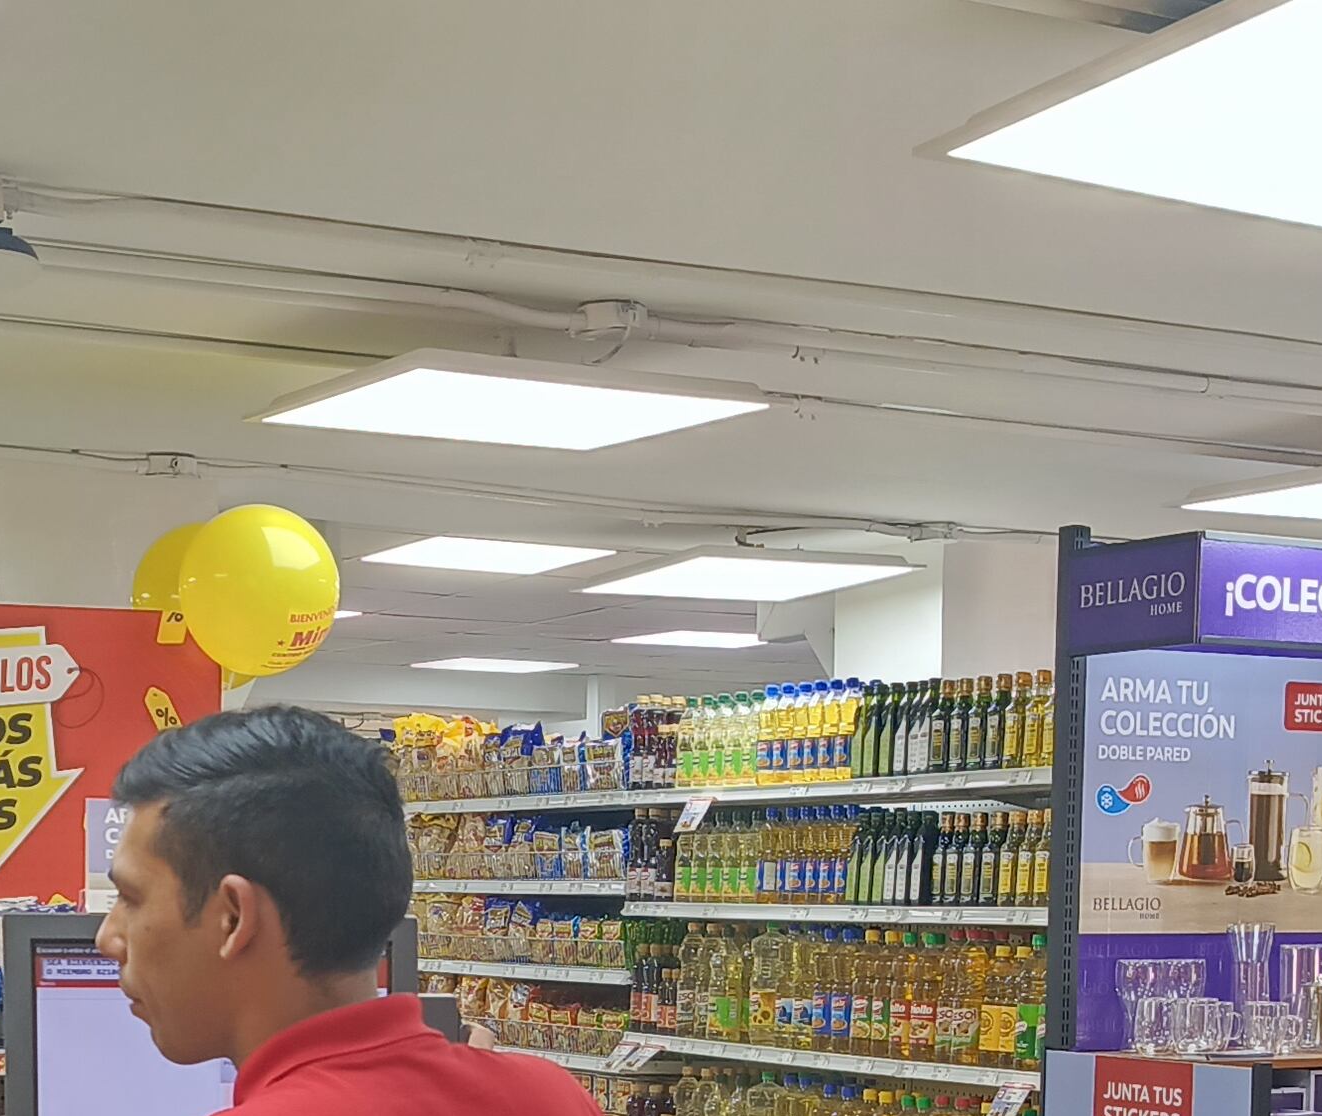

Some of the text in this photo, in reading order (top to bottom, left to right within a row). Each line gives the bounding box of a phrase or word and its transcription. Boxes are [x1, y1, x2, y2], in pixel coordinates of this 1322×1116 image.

[1080, 571, 1186, 609] BELLAGIO
[1150, 602, 1183, 617] HOME
[0, 655, 52, 693] LOS
[1101, 677, 1209, 706] ARMA TU
[1100, 706, 1236, 739] COLECCIÓN
[1098, 744, 1191, 762] DOBLE PARED
[1093, 896, 1162, 912] BELLAGIO
[1103, 1081, 1183, 1108] JUNTA TUS
